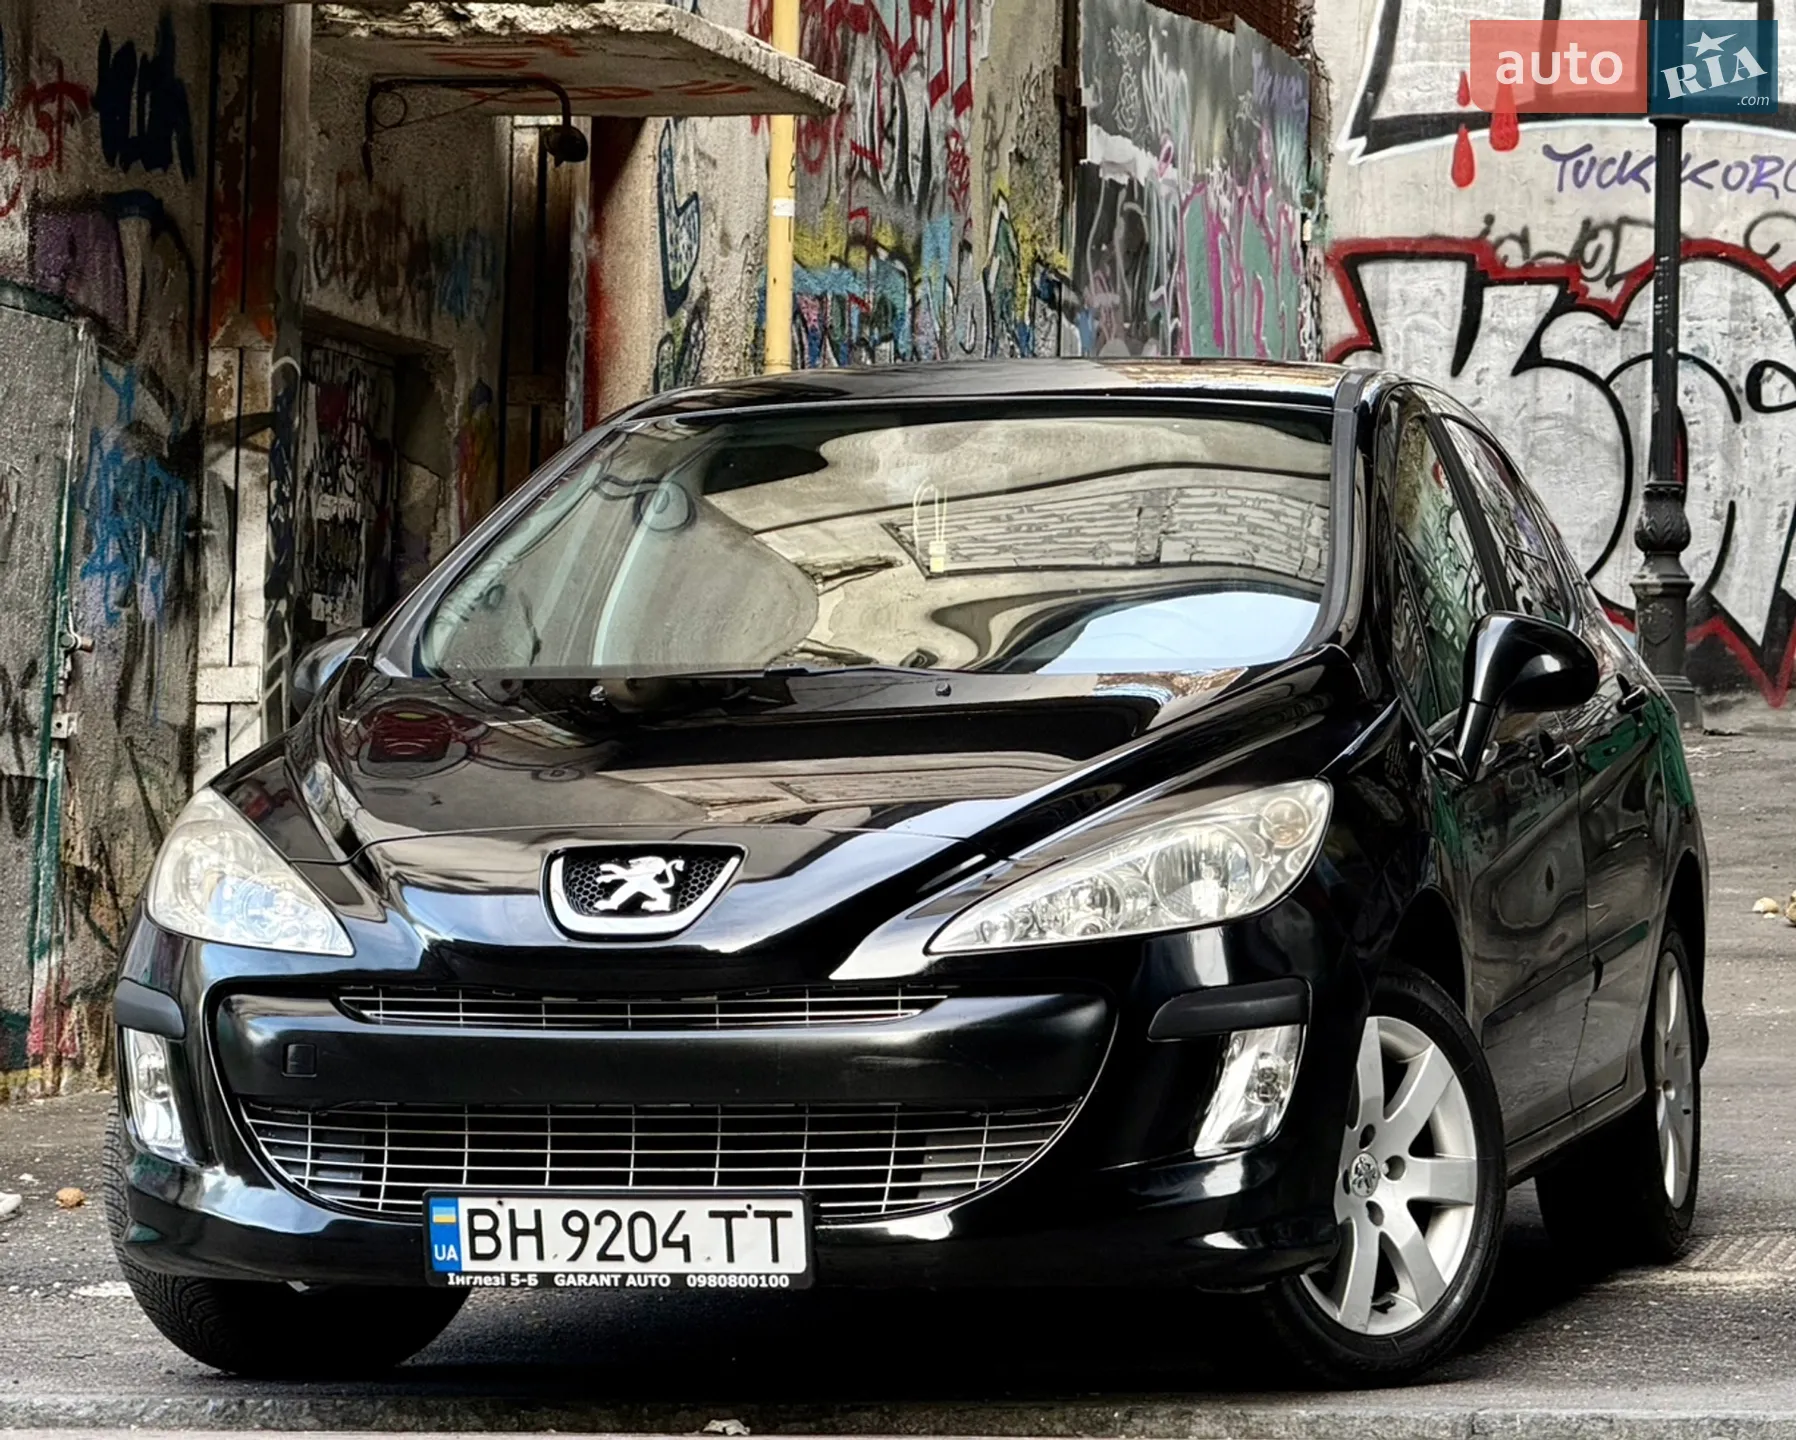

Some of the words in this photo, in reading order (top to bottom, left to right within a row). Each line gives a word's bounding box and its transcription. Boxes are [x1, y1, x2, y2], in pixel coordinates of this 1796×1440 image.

[467, 1208, 544, 1261] BH
[561, 1209, 692, 1263] 9204
[708, 1210, 793, 1263] TT
[434, 1244, 459, 1262] UA
[447, 1273, 506, 1287] Інглезі
[510, 1273, 539, 1287] 5-Б
[553, 1274, 622, 1287] GARANT
[625, 1274, 671, 1287] AUTO
[686, 1275, 790, 1288] 0980800100
